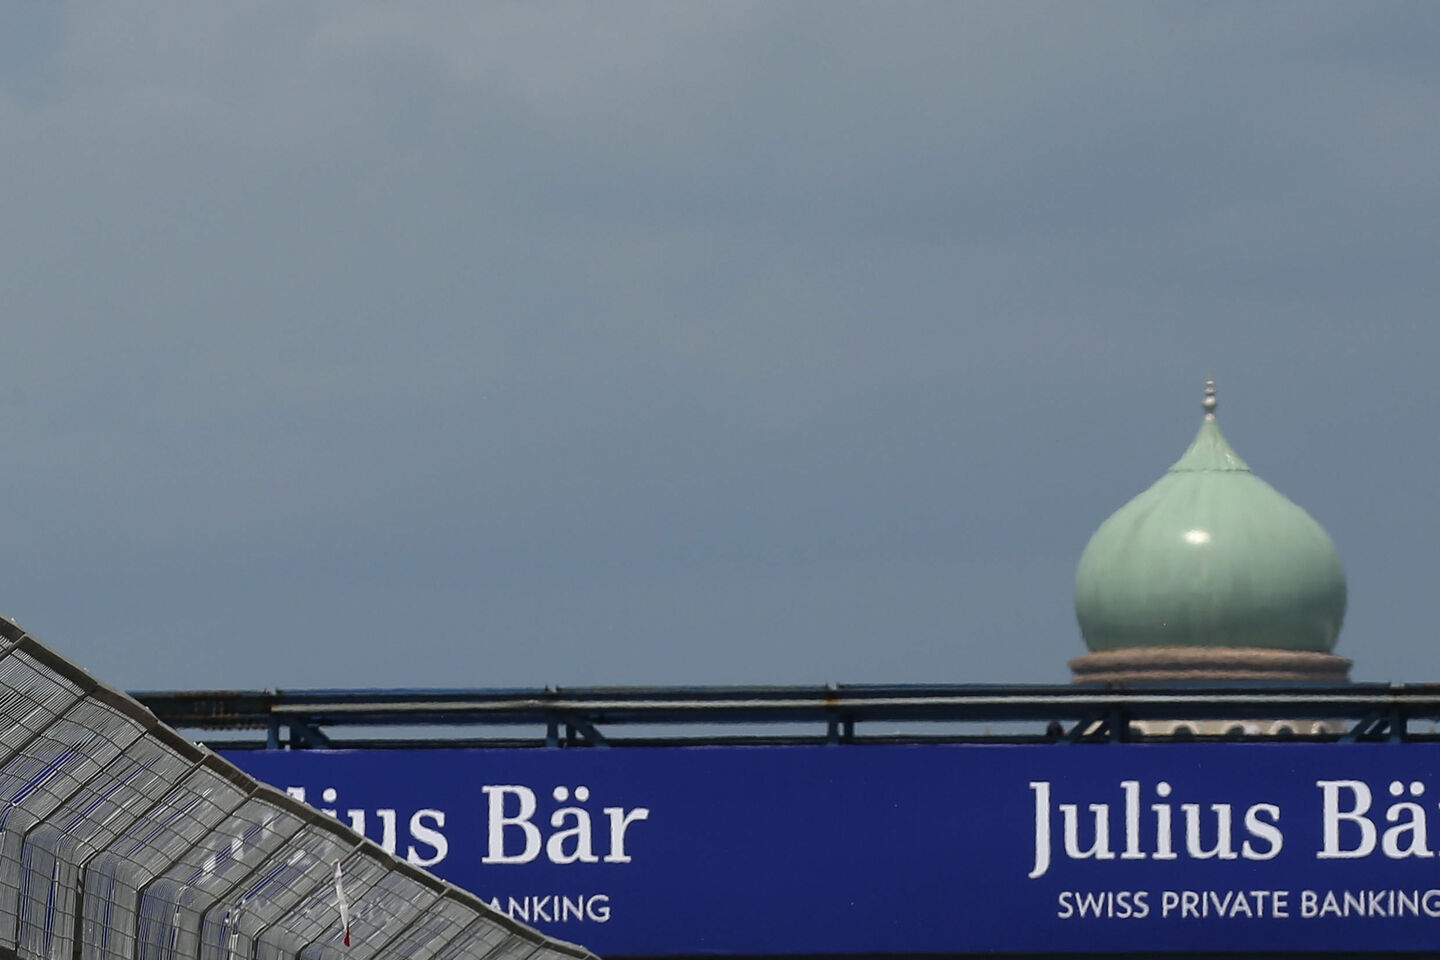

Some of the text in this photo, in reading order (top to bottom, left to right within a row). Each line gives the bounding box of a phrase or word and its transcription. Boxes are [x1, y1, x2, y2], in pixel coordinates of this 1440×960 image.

[481, 785, 650, 864] Bär
[1028, 780, 1284, 879] Julius
[489, 894, 611, 923] ANKING
[1057, 891, 1150, 919] SWISS
[1161, 890, 1290, 919] PRIVATE
